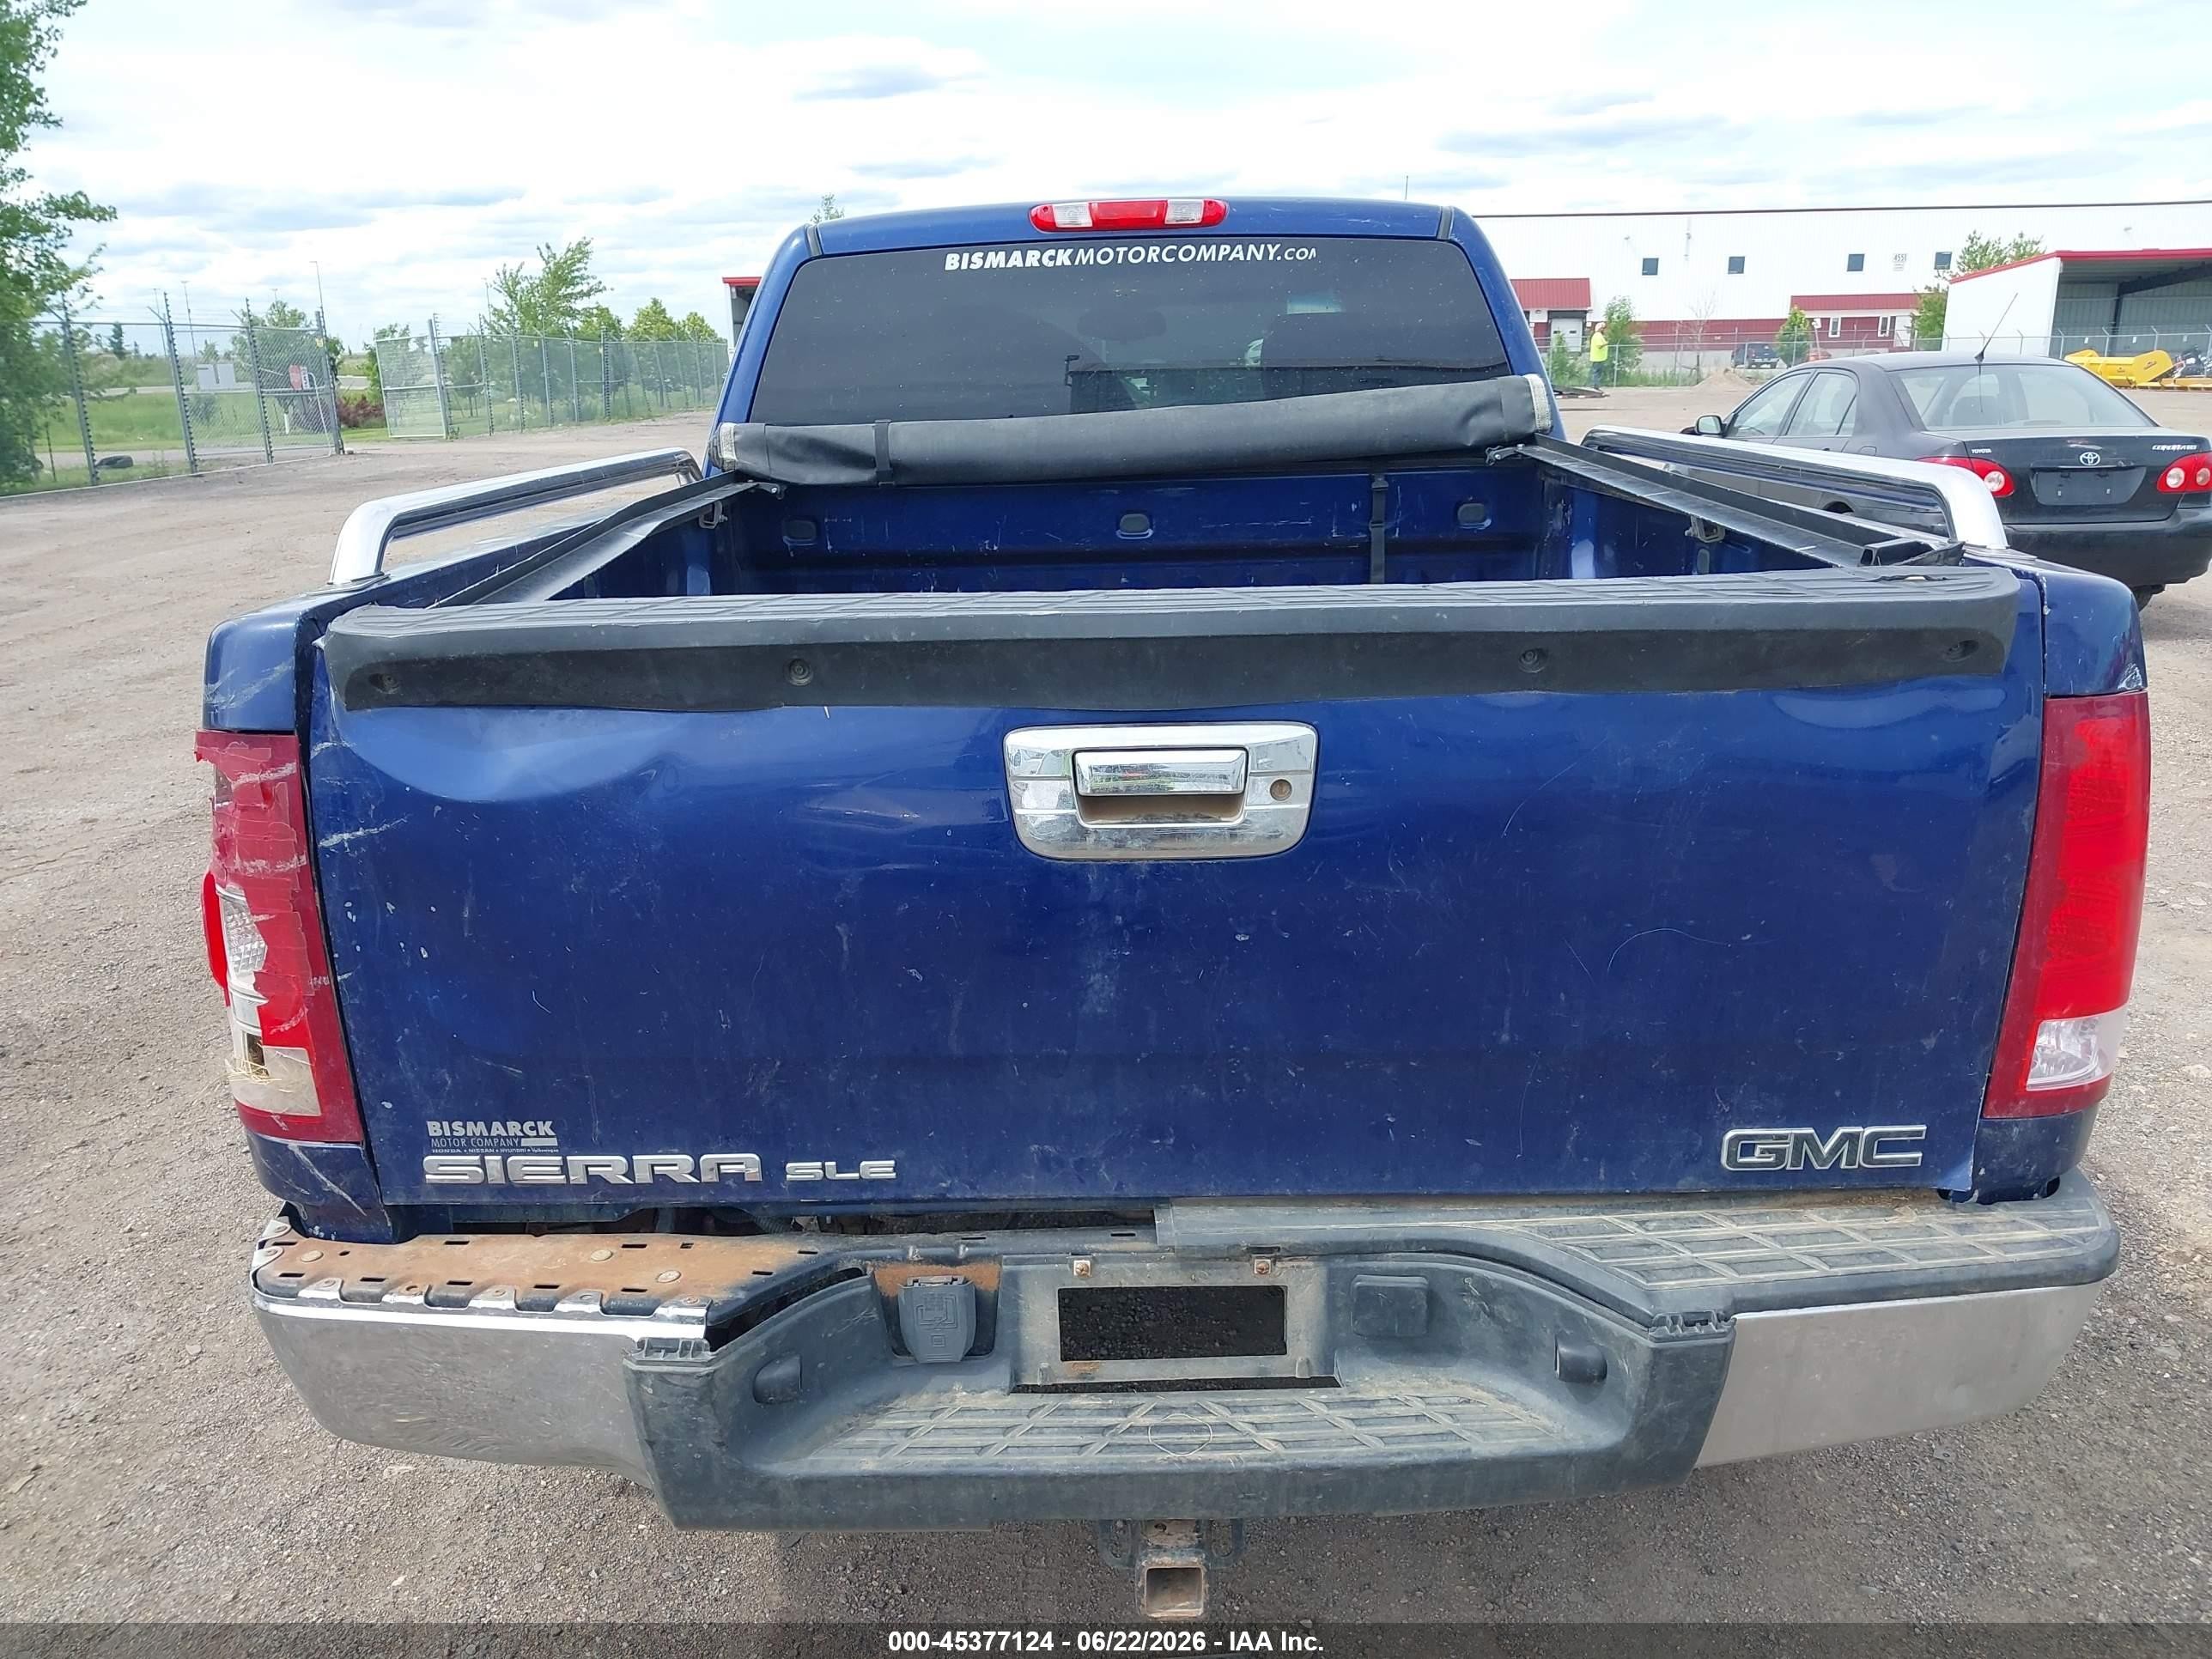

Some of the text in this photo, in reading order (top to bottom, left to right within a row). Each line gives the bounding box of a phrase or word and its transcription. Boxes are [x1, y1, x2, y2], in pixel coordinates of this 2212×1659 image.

[427, 1121, 556, 1136] BISMARCK
[431, 1137, 519, 1147] MOTOR COMPANY
[1721, 1125, 1927, 1170] GMC
[422, 1153, 763, 1185] SIERRA
[785, 1159, 897, 1182] SLE
